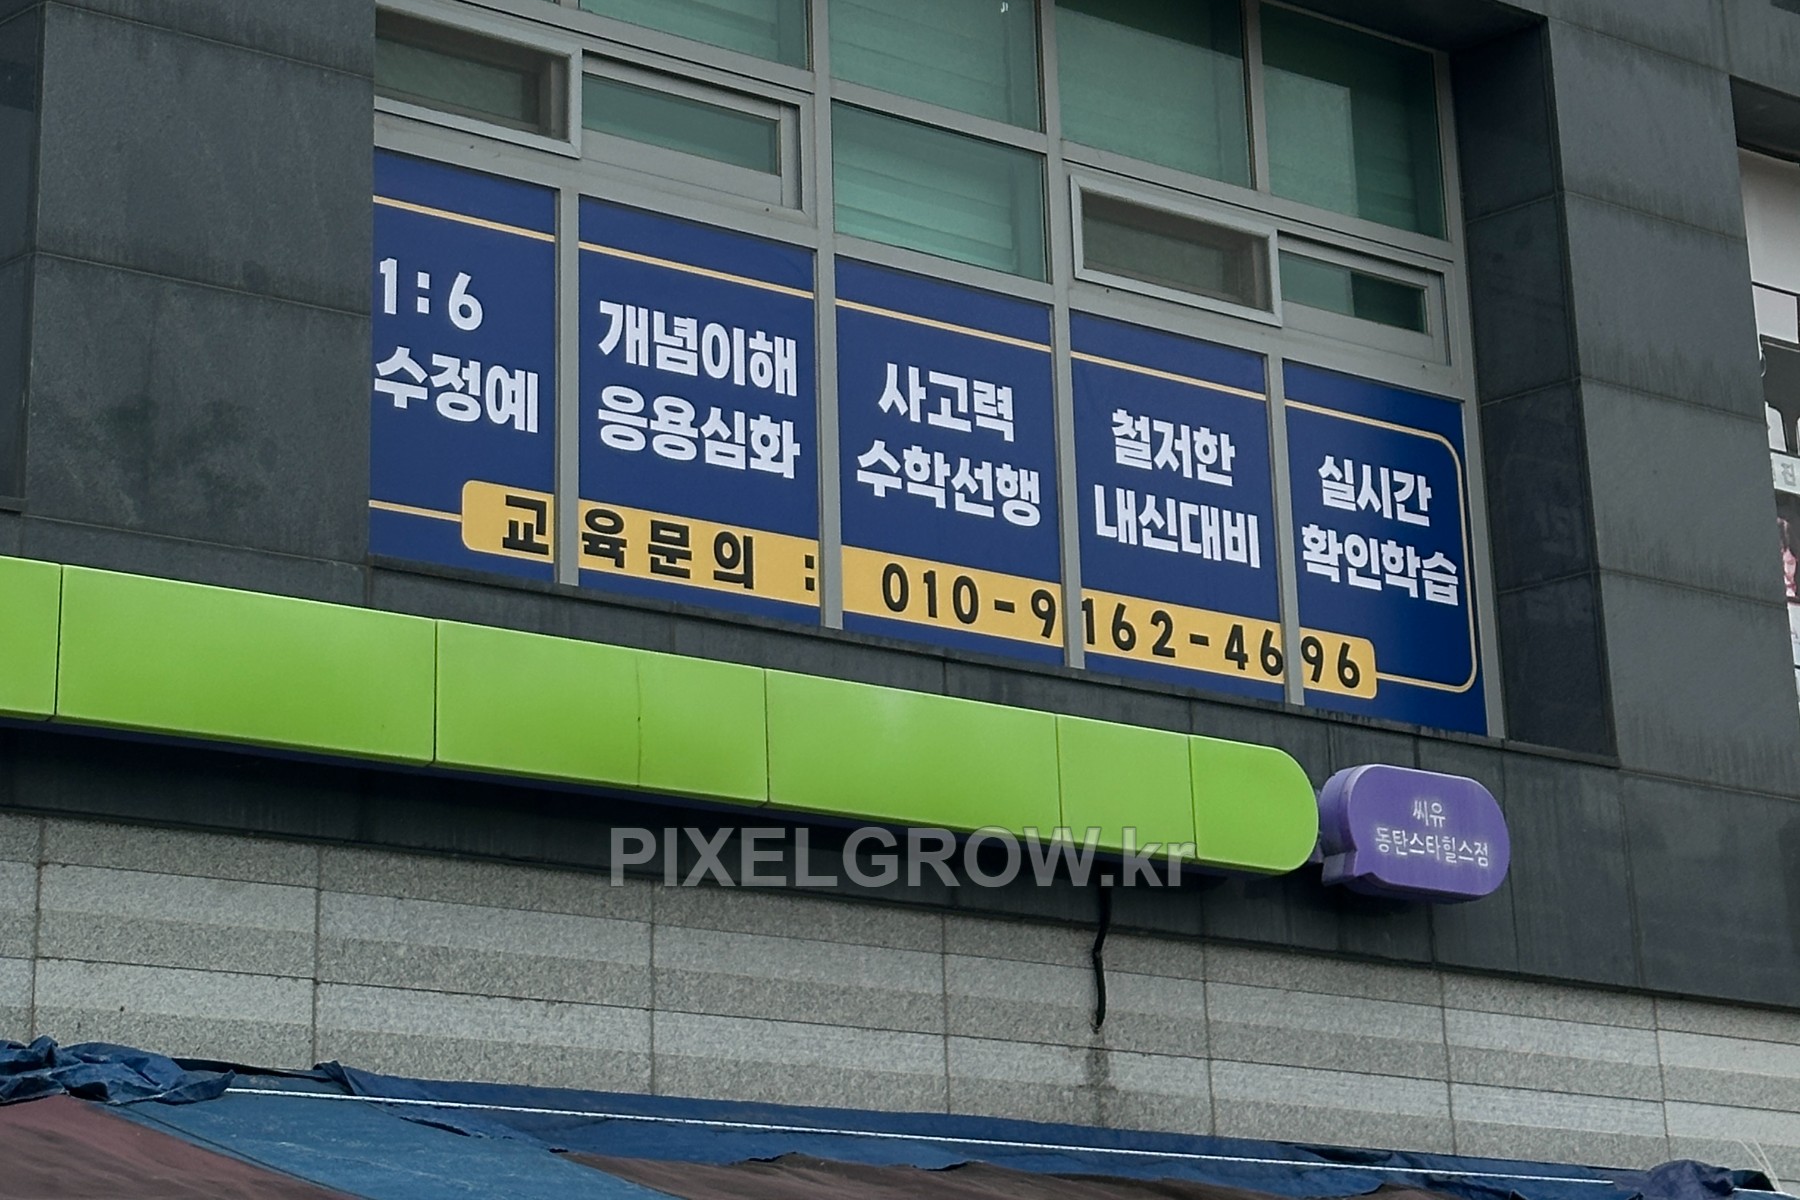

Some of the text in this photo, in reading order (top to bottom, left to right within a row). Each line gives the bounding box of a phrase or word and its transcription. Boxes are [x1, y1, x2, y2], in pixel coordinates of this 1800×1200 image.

[599, 300, 797, 397] 개념이해
[598, 385, 800, 479] 응용심화
[878, 362, 1014, 443] 사고력
[856, 439, 1042, 528] 수학선행
[1112, 408, 1236, 487] 철저한
[1094, 484, 1261, 569] 내신대비
[1318, 454, 1432, 527] 실시간
[502, 494, 755, 590] 교육문의
[1302, 523, 1459, 606] 확인학습
[1375, 826, 1489, 868] 동탄스타힐스점
[1413, 800, 1446, 828] 씨유
